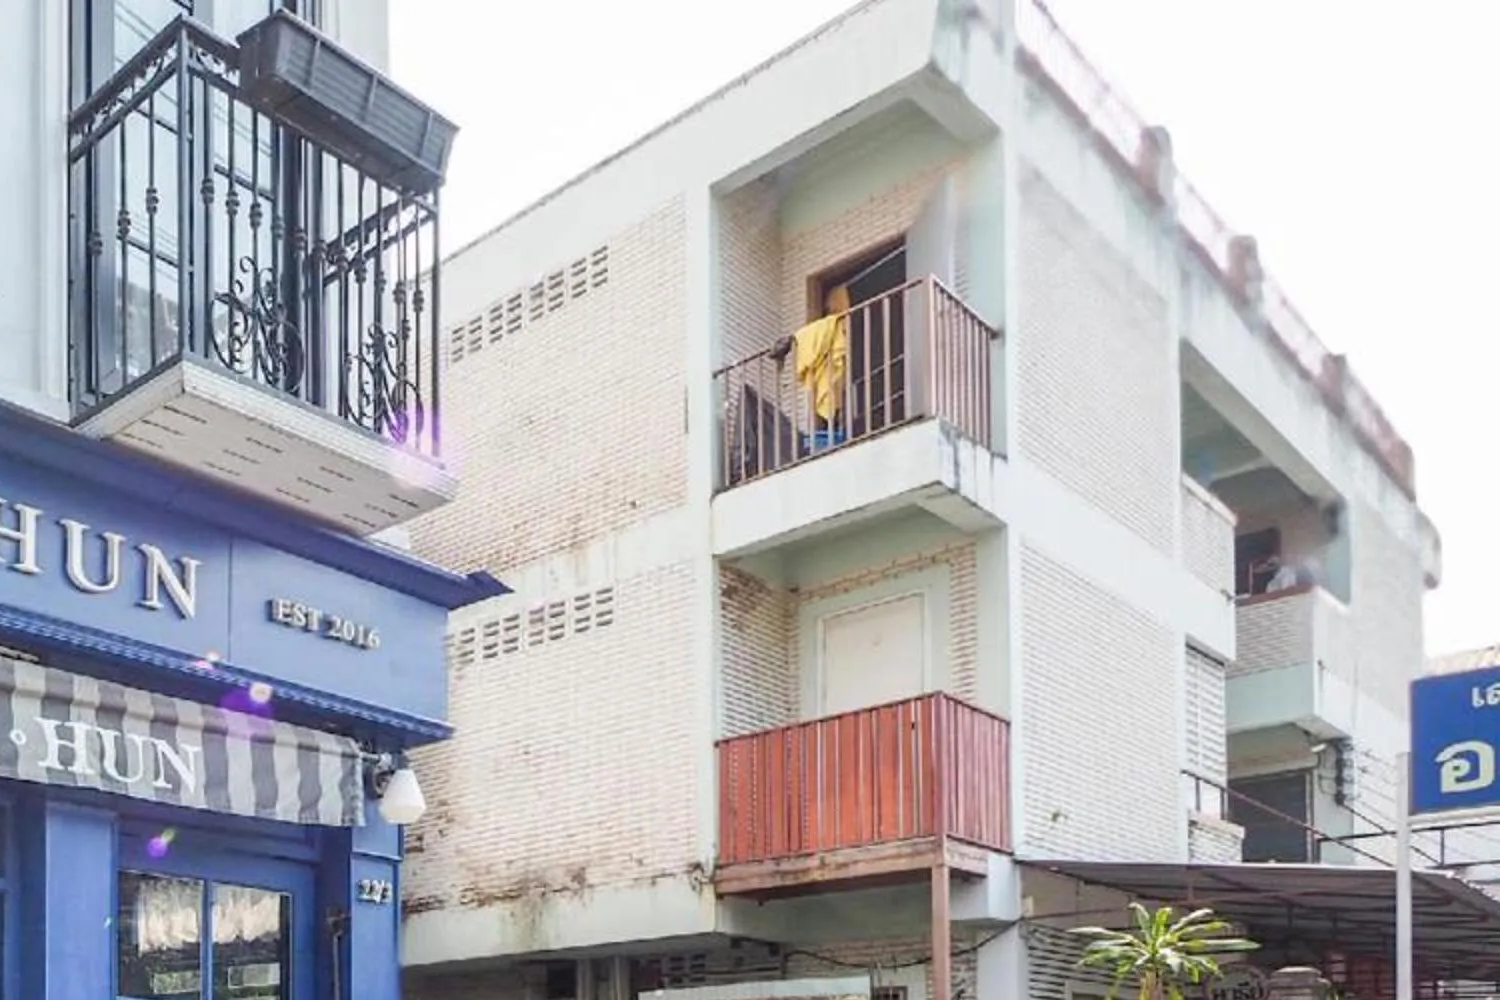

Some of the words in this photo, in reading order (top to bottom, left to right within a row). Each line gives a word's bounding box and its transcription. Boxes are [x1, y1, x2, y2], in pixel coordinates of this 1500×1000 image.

[271, 598, 323, 631] EST
[328, 614, 381, 648] 2016
[33, 716, 204, 793] HUN
